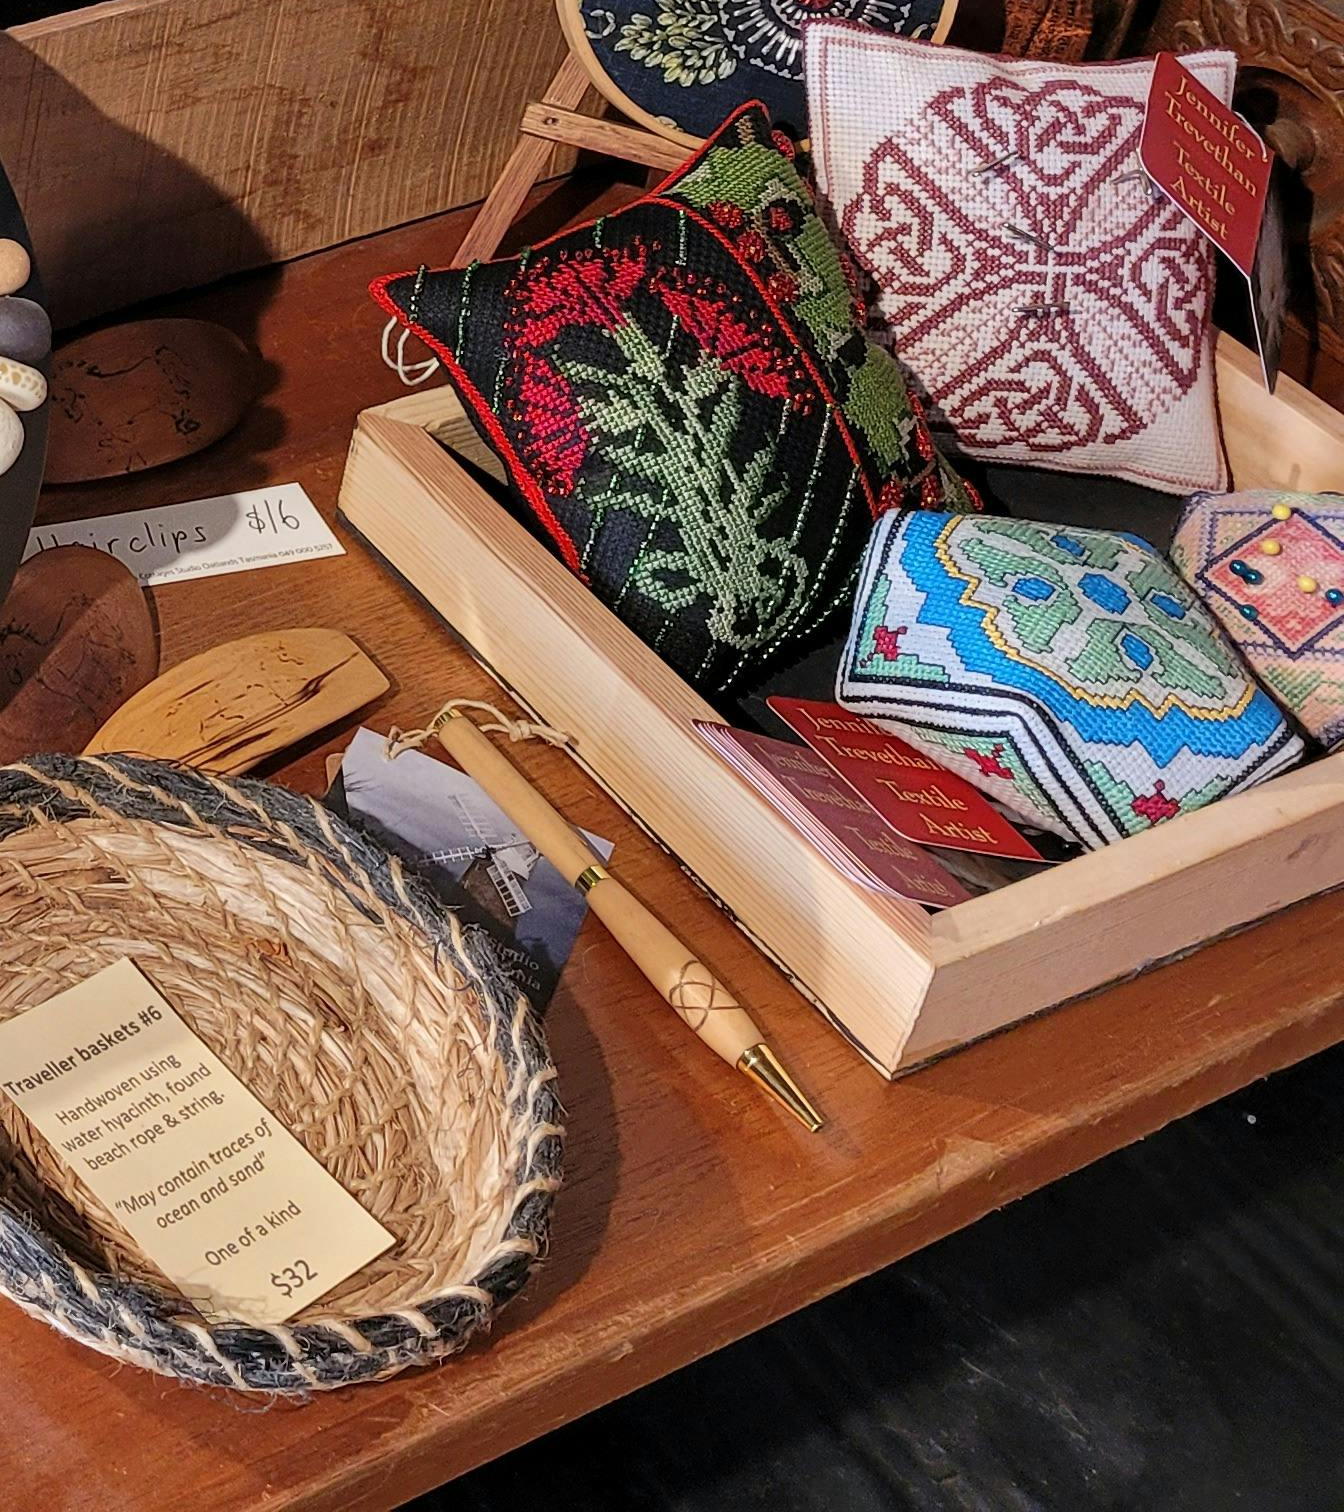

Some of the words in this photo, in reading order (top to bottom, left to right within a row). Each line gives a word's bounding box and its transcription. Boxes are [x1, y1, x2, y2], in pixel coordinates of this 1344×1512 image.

[1165, 91, 1257, 197] Trevethan
[1176, 74, 1255, 160] Jennifer
[1170, 176, 1228, 240] Artist
[1173, 141, 1235, 215] Textile
[36, 521, 208, 554] irclips
[246, 499, 300, 534] $16
[797, 708, 893, 737] Jennif
[876, 777, 969, 811] Textile
[918, 813, 999, 845] Artist
[2, 1055, 77, 1098] Traveller
[75, 1022, 141, 1061] baskets
[140, 1005, 163, 1028] #6
[55, 1076, 141, 1126] Handwoven
[139, 1054, 182, 1079] using
[61, 1125, 104, 1153] water
[103, 1091, 170, 1132] hyacinth,
[166, 1063, 212, 1096] found
[83, 1141, 132, 1171] beach
[131, 1123, 166, 1148] rope
[162, 1113, 180, 1129] &
[180, 1091, 225, 1121] string.
[115, 1190, 157, 1215] “May
[157, 1159, 211, 1198] contain
[208, 1133, 255, 1165] traces
[255, 1117, 273, 1138] of
[156, 1199, 201, 1229] ocean
[200, 1176, 229, 1204] and
[229, 1150, 266, 1187] sand”
[204, 1243, 240, 1266] One
[238, 1226, 257, 1247] of
[255, 1224, 269, 1237] a
[267, 1200, 302, 1230] kind
[270, 1259, 319, 1299] $32
